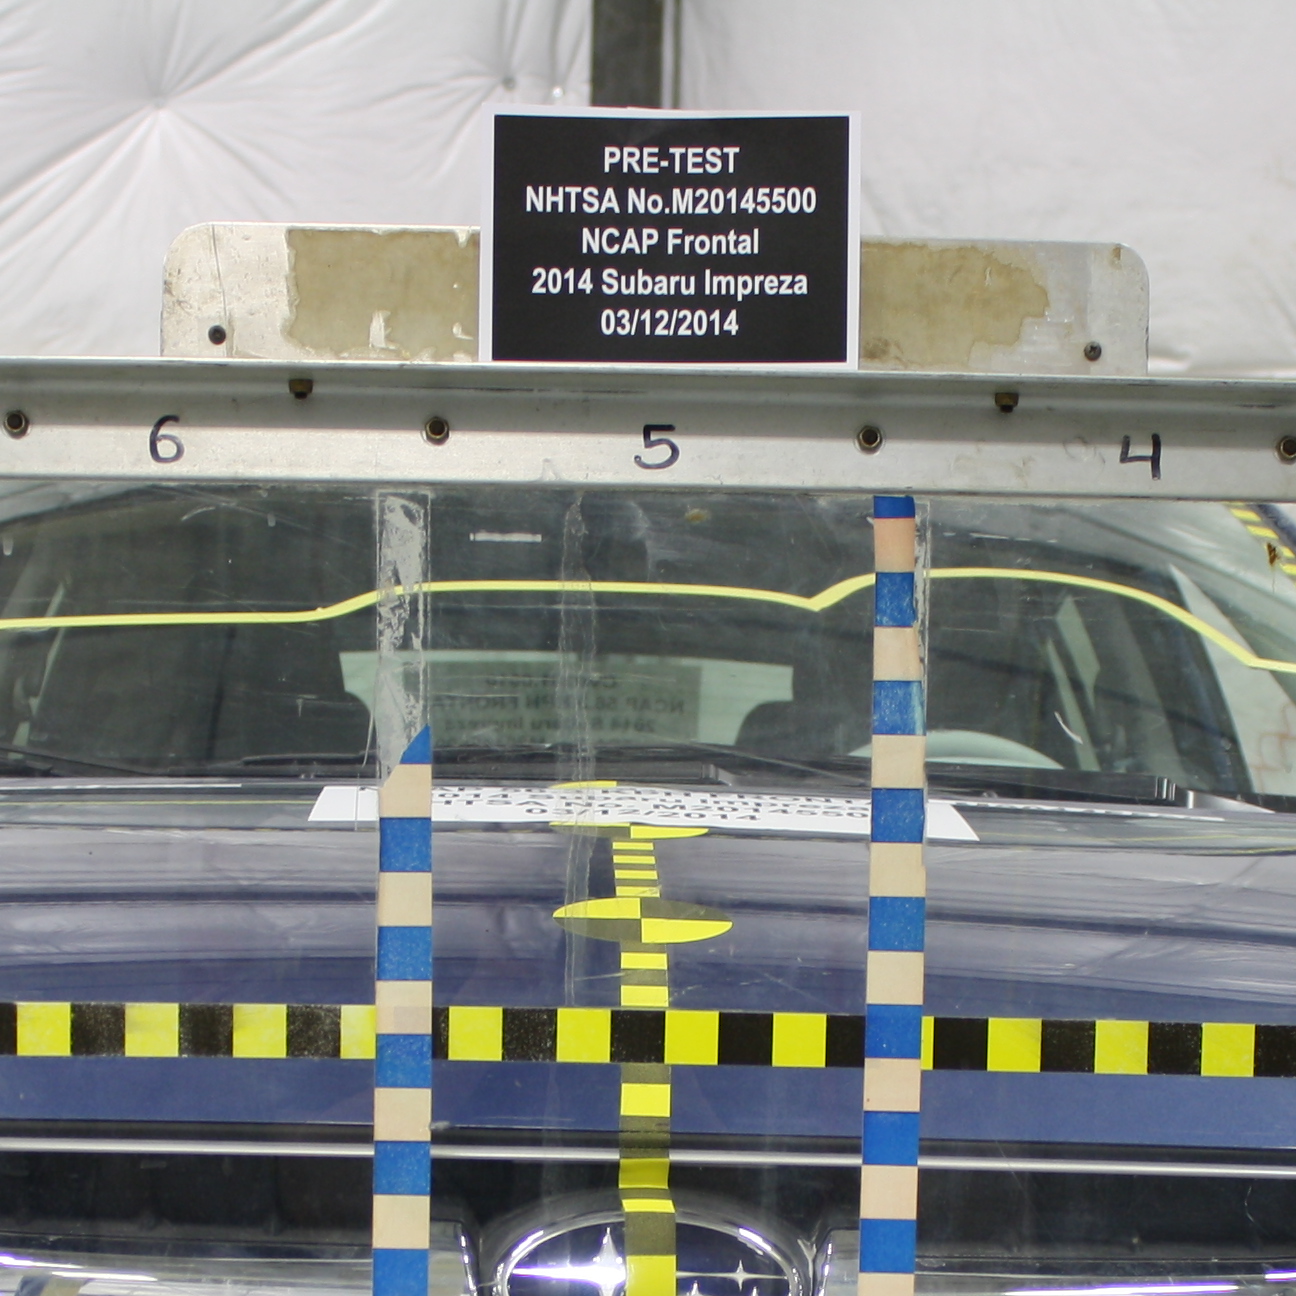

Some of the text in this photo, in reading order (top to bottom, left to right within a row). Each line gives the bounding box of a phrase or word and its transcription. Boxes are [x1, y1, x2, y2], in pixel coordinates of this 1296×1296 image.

[604, 146, 740, 174] PRE-TEST
[525, 185, 817, 215] NHTSA No.M20145500
[582, 227, 759, 255] NCAP Frontal
[531, 266, 808, 302] 2014 Subaru Impreza
[600, 308, 739, 337] 03/12/2014
[148, 414, 185, 465] 6
[633, 423, 680, 471] 5
[1119, 433, 1162, 481] 4
[524, 807, 760, 821] 03/12/2014
[652, 804, 871, 818] M2014550
